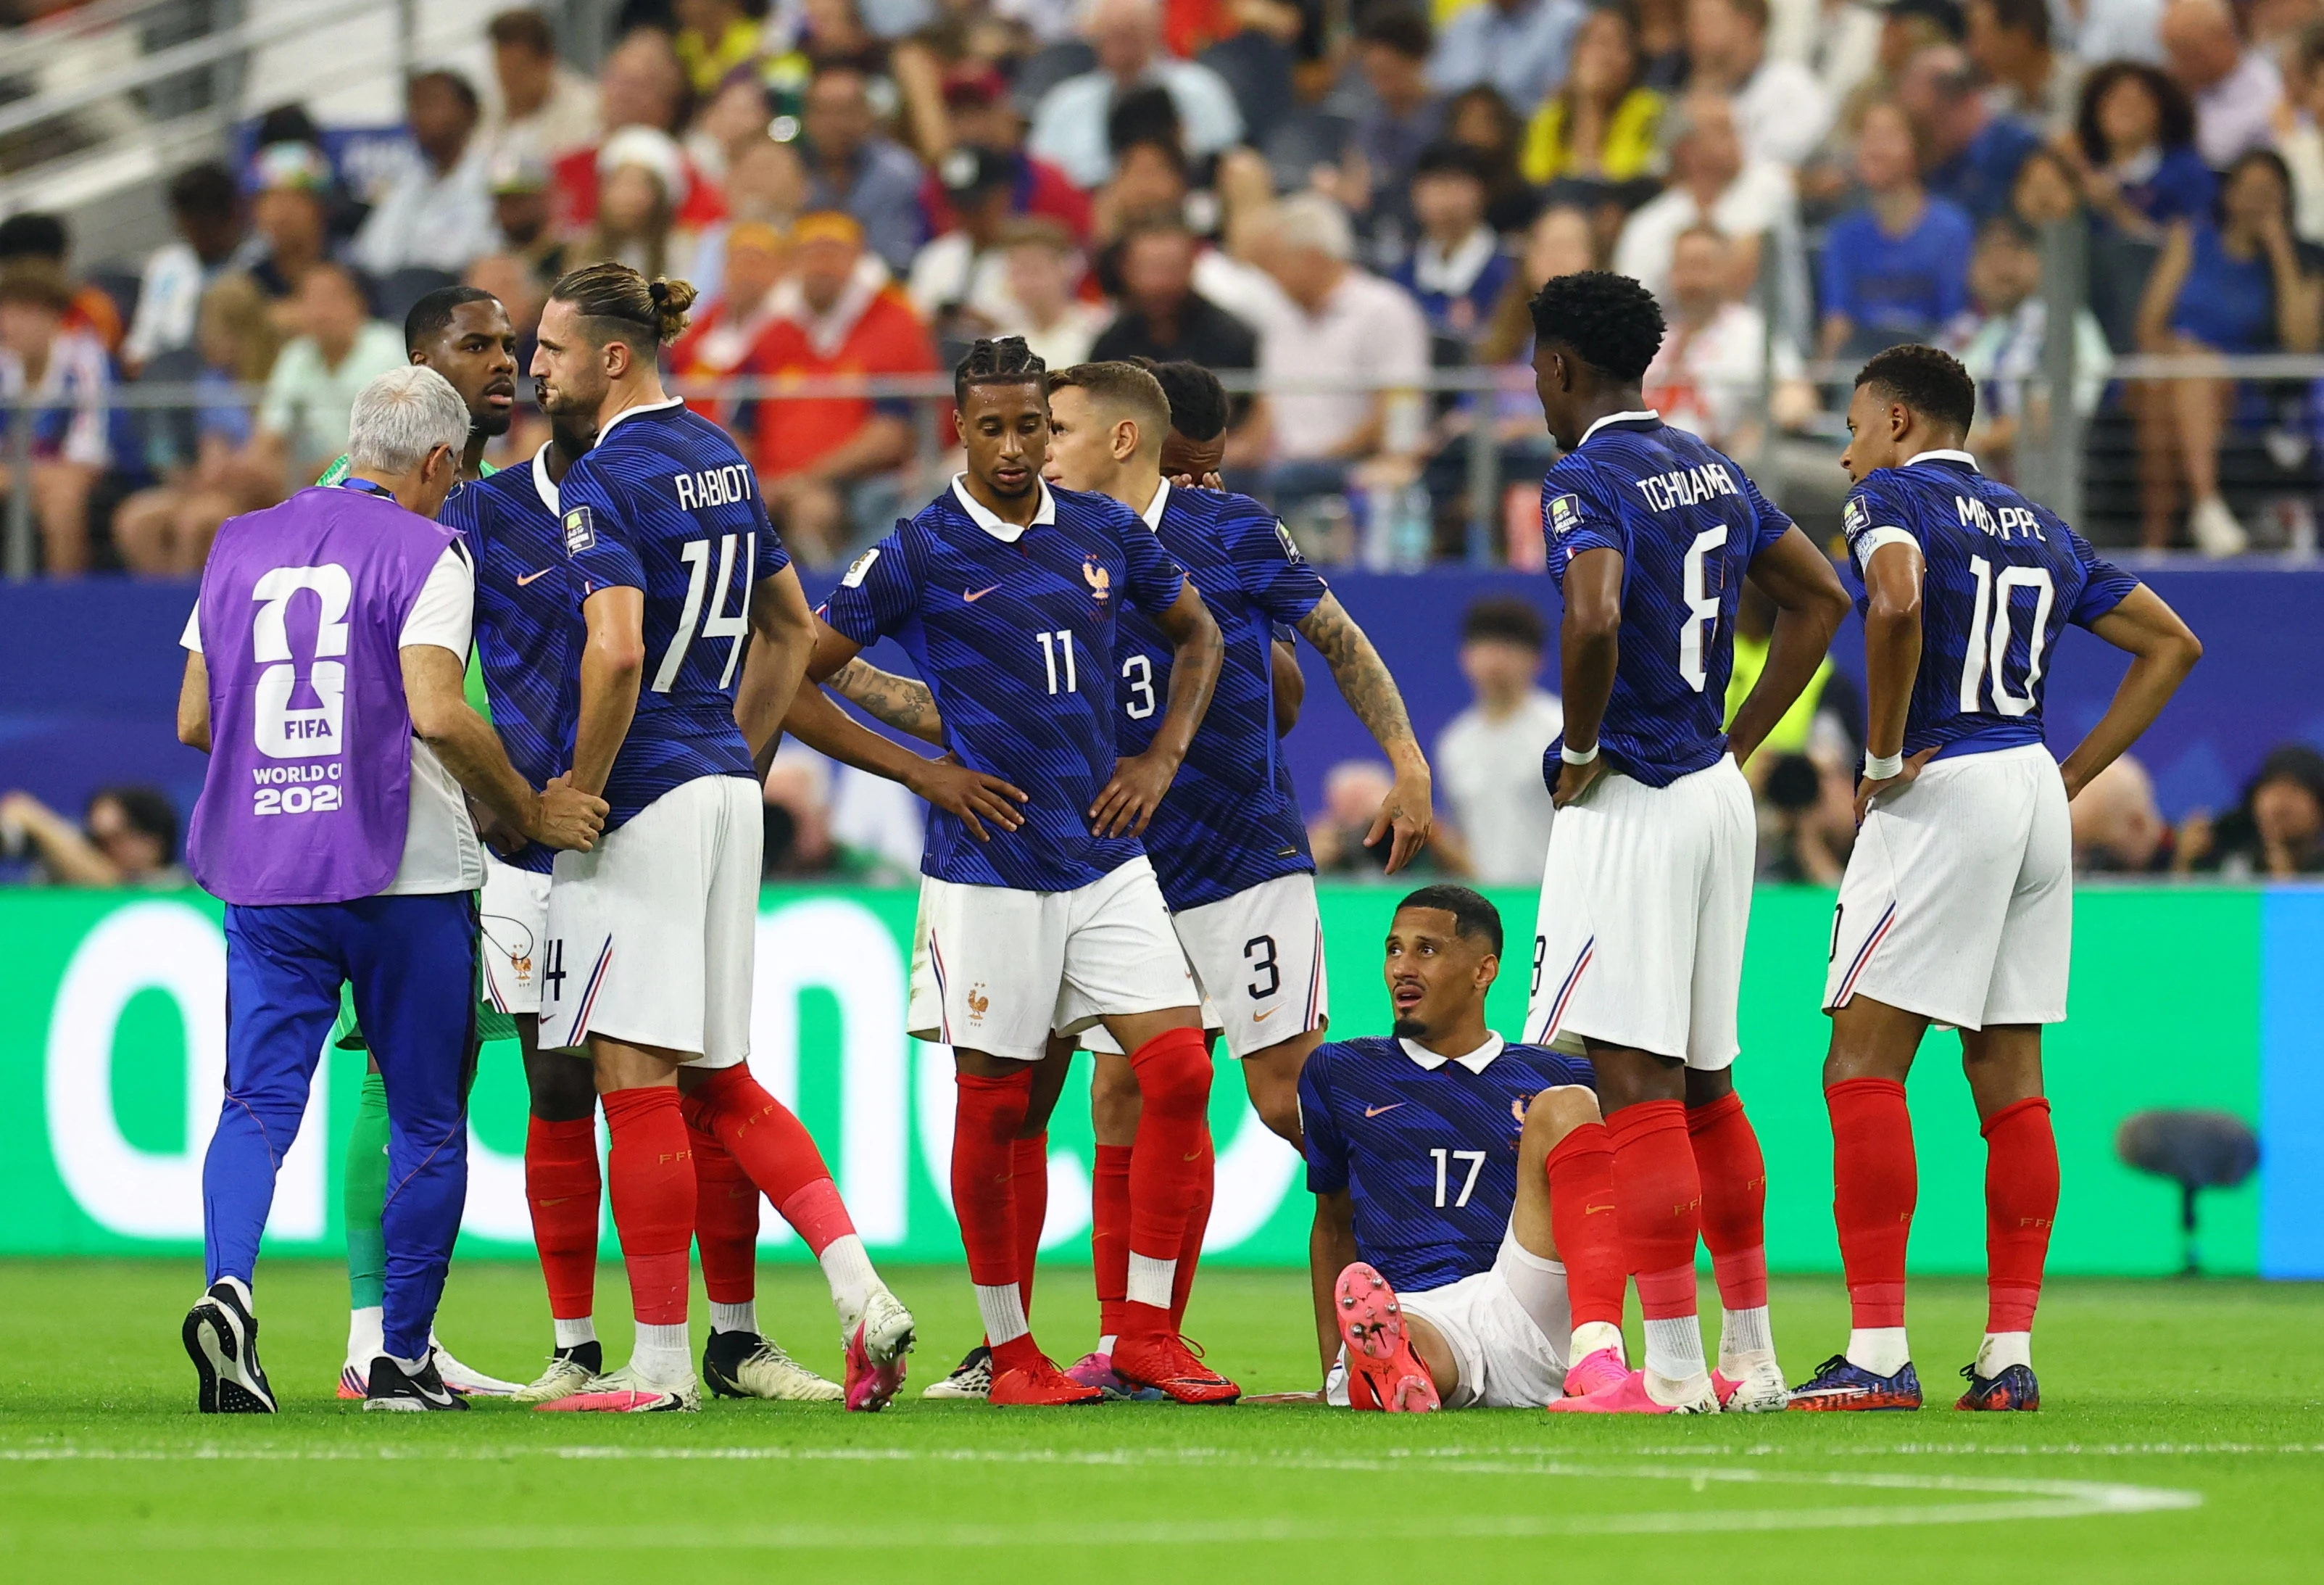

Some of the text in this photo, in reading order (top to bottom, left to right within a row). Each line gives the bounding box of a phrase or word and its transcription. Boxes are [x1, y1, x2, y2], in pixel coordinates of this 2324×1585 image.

[675, 464, 752, 511] RABIOT
[651, 532, 756, 692] 14
[1960, 554, 2056, 716] 10
[1036, 630, 1076, 695] 11
[1122, 655, 1155, 720] 3
[284, 719, 333, 740] FIFA
[253, 765, 325, 785] WORLD
[254, 784, 342, 816] 202
[1244, 935, 1280, 1000] 3
[737, 1105, 773, 1138] FFF
[1429, 1148, 1486, 1208] 17
[1748, 1175, 1766, 1191] FF
[1674, 1194, 1701, 1216] FF
